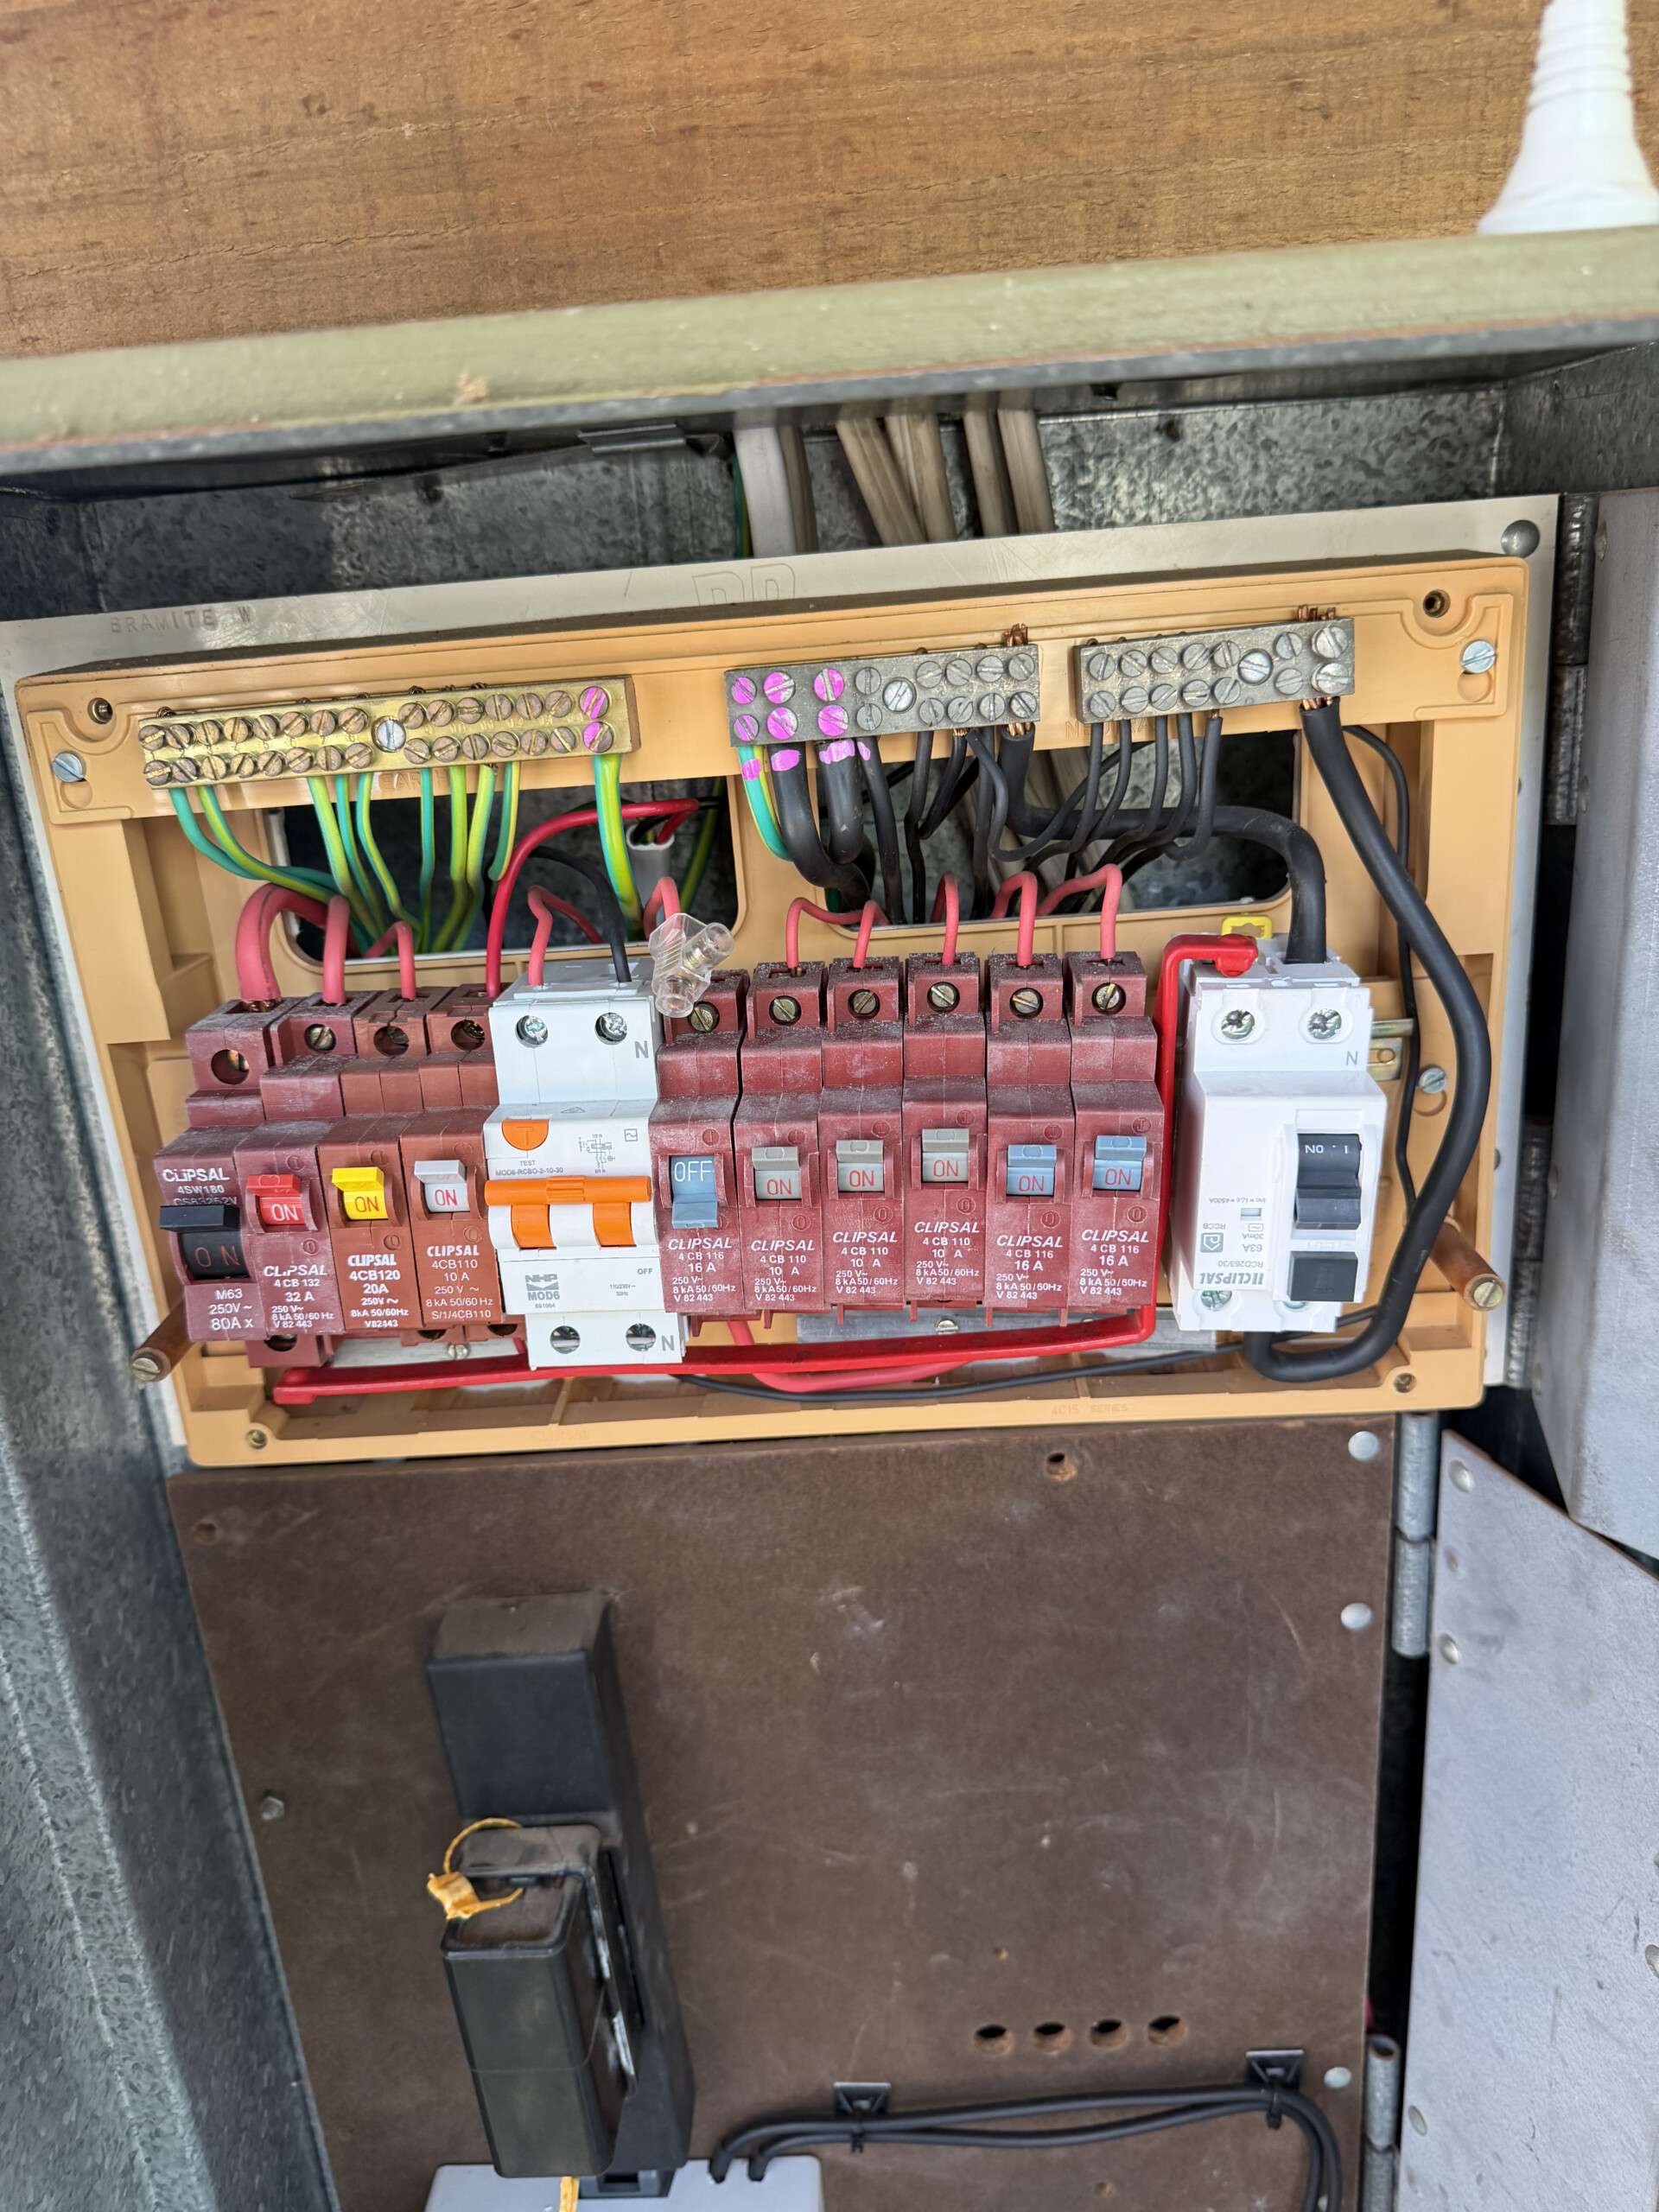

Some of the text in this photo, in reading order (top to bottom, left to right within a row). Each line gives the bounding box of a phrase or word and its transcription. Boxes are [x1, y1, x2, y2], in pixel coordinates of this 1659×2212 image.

[633, 1040, 649, 1058] N
[1345, 1051, 1358, 1065] N
[1305, 1143, 1324, 1154] ON
[162, 1168, 230, 1182] CLIPSAL
[674, 1160, 713, 1182] OFF
[933, 1160, 958, 1178] ON
[849, 1170, 874, 1187] ON
[1104, 1168, 1131, 1185] ON
[767, 1178, 791, 1195] ON
[1018, 1175, 1044, 1192] ON
[434, 1189, 457, 1206] ON
[355, 1196, 379, 1213] ON
[270, 1203, 299, 1221] ON
[914, 1222, 980, 1233] CLIPSAL
[832, 1231, 898, 1243] CLIPSAL
[996, 1235, 1063, 1248] CLIPSAL
[1081, 1230, 1149, 1243] CLIPSAL
[668, 1237, 733, 1249] CLIPSAL
[751, 1240, 815, 1251] CLIPSAL
[427, 1245, 480, 1257] CLIPSAL
[932, 1249, 963, 1258] 10 A
[347, 1254, 397, 1267] CLIPSAL
[431, 1259, 478, 1269] 4CB110
[850, 1259, 881, 1268] 10 A
[1014, 1261, 1043, 1271] 16 A
[1099, 1255, 1128, 1266] 16 A
[264, 1265, 327, 1276] CLIPSAL
[688, 1262, 716, 1273] 16 A
[769, 1267, 799, 1275] 10 A
[349, 1270, 401, 1281] 4CB120
[444, 1272, 469, 1281] 10 A
[525, 1274, 557, 1282] NHP
[216, 1288, 242, 1300] M63
[363, 1283, 389, 1294] 20A
[435, 1286, 454, 1294] 250
[286, 1292, 315, 1302] 32 A
[528, 1291, 560, 1301] MOD6
[212, 1318, 241, 1330] 80A
[662, 1335, 676, 1351] N
